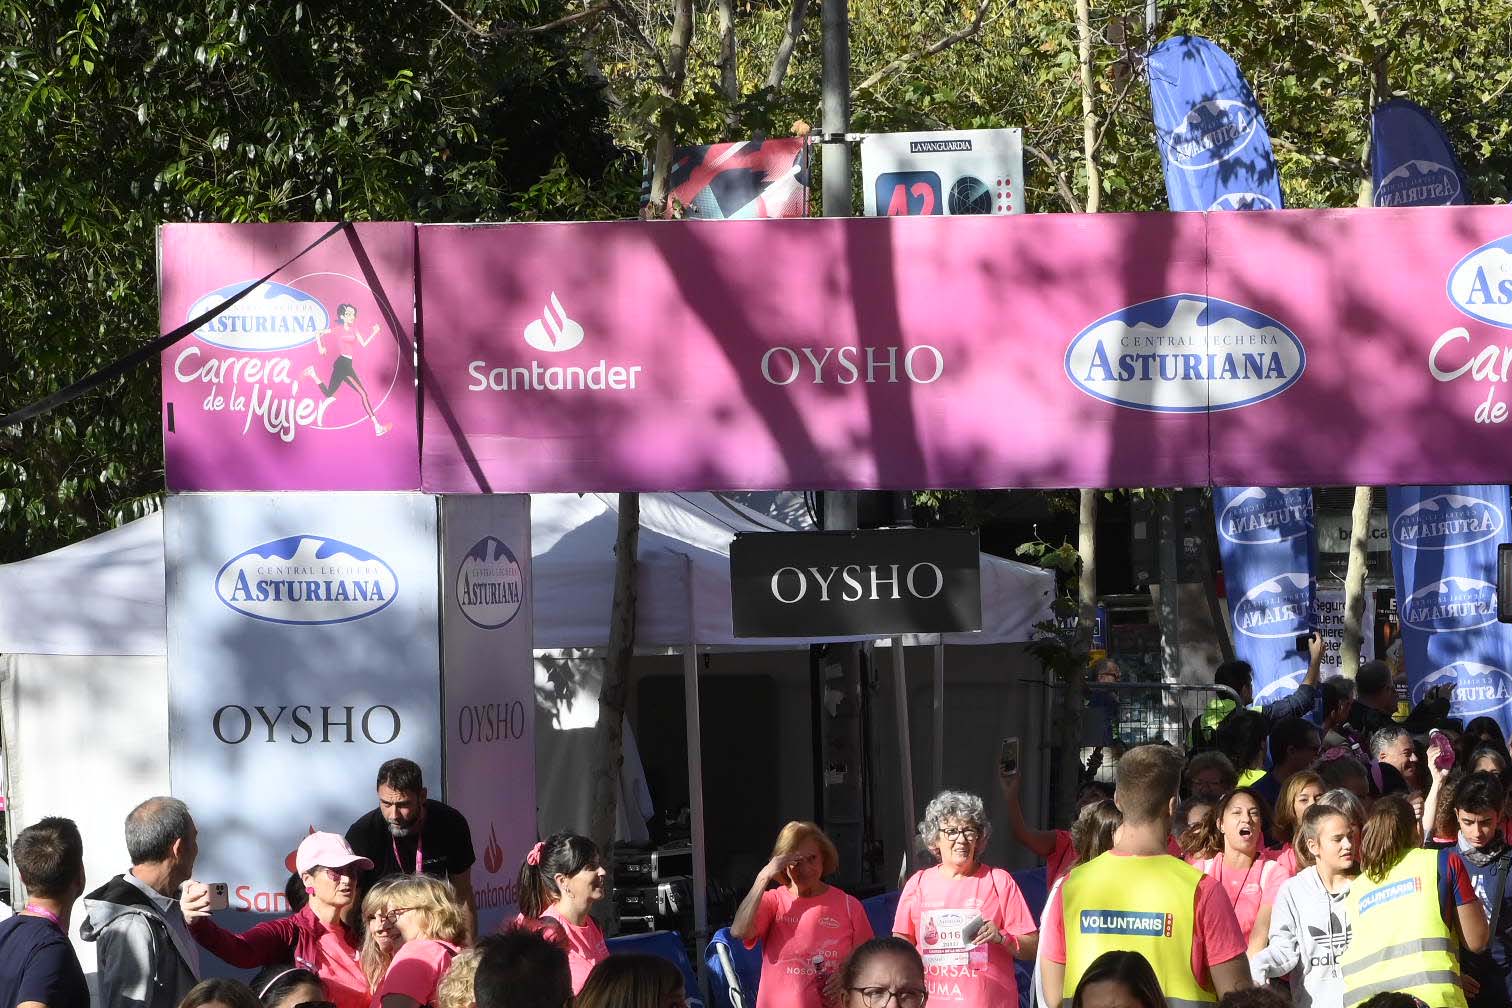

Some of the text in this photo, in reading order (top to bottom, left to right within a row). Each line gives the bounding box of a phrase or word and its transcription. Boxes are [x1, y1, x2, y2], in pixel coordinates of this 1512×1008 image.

[1120, 334, 1194, 347] CENTRAL
[175, 346, 293, 384] Carrera
[468, 358, 642, 391] Santander
[760, 343, 945, 386] OYSHO
[1084, 339, 1287, 382] ASTURIANA
[203, 381, 337, 442] de la Mujer
[1474, 386, 1508, 424] de
[230, 568, 386, 602] ASTURIANA
[257, 566, 314, 575] CENTRAL
[461, 564, 520, 607] ASTURIANA
[771, 562, 944, 604] OYSHO
[212, 704, 402, 745] OYSHO
[458, 700, 525, 745] OYSHO
[940, 931, 960, 940] 016
[1082, 916, 1162, 931] VOLUNTARIS
